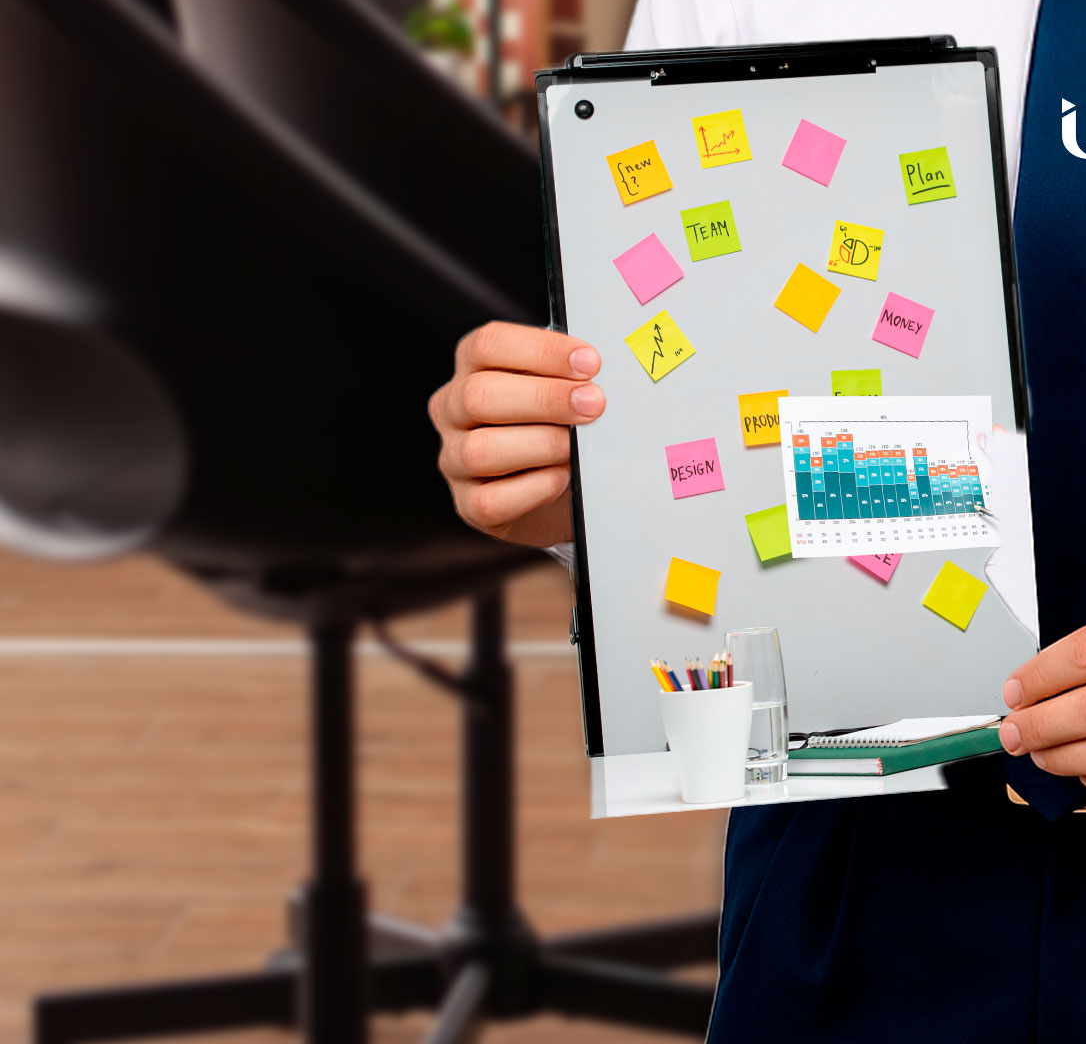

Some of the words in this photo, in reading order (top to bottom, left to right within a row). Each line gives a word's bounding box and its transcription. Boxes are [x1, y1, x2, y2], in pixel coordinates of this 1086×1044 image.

[625, 158, 651, 173] new
[906, 162, 945, 186] Plan
[686, 220, 730, 243] TEAM
[880, 309, 923, 334] MONEY
[744, 414, 780, 433] PRODU
[670, 459, 715, 482] DESIGN
